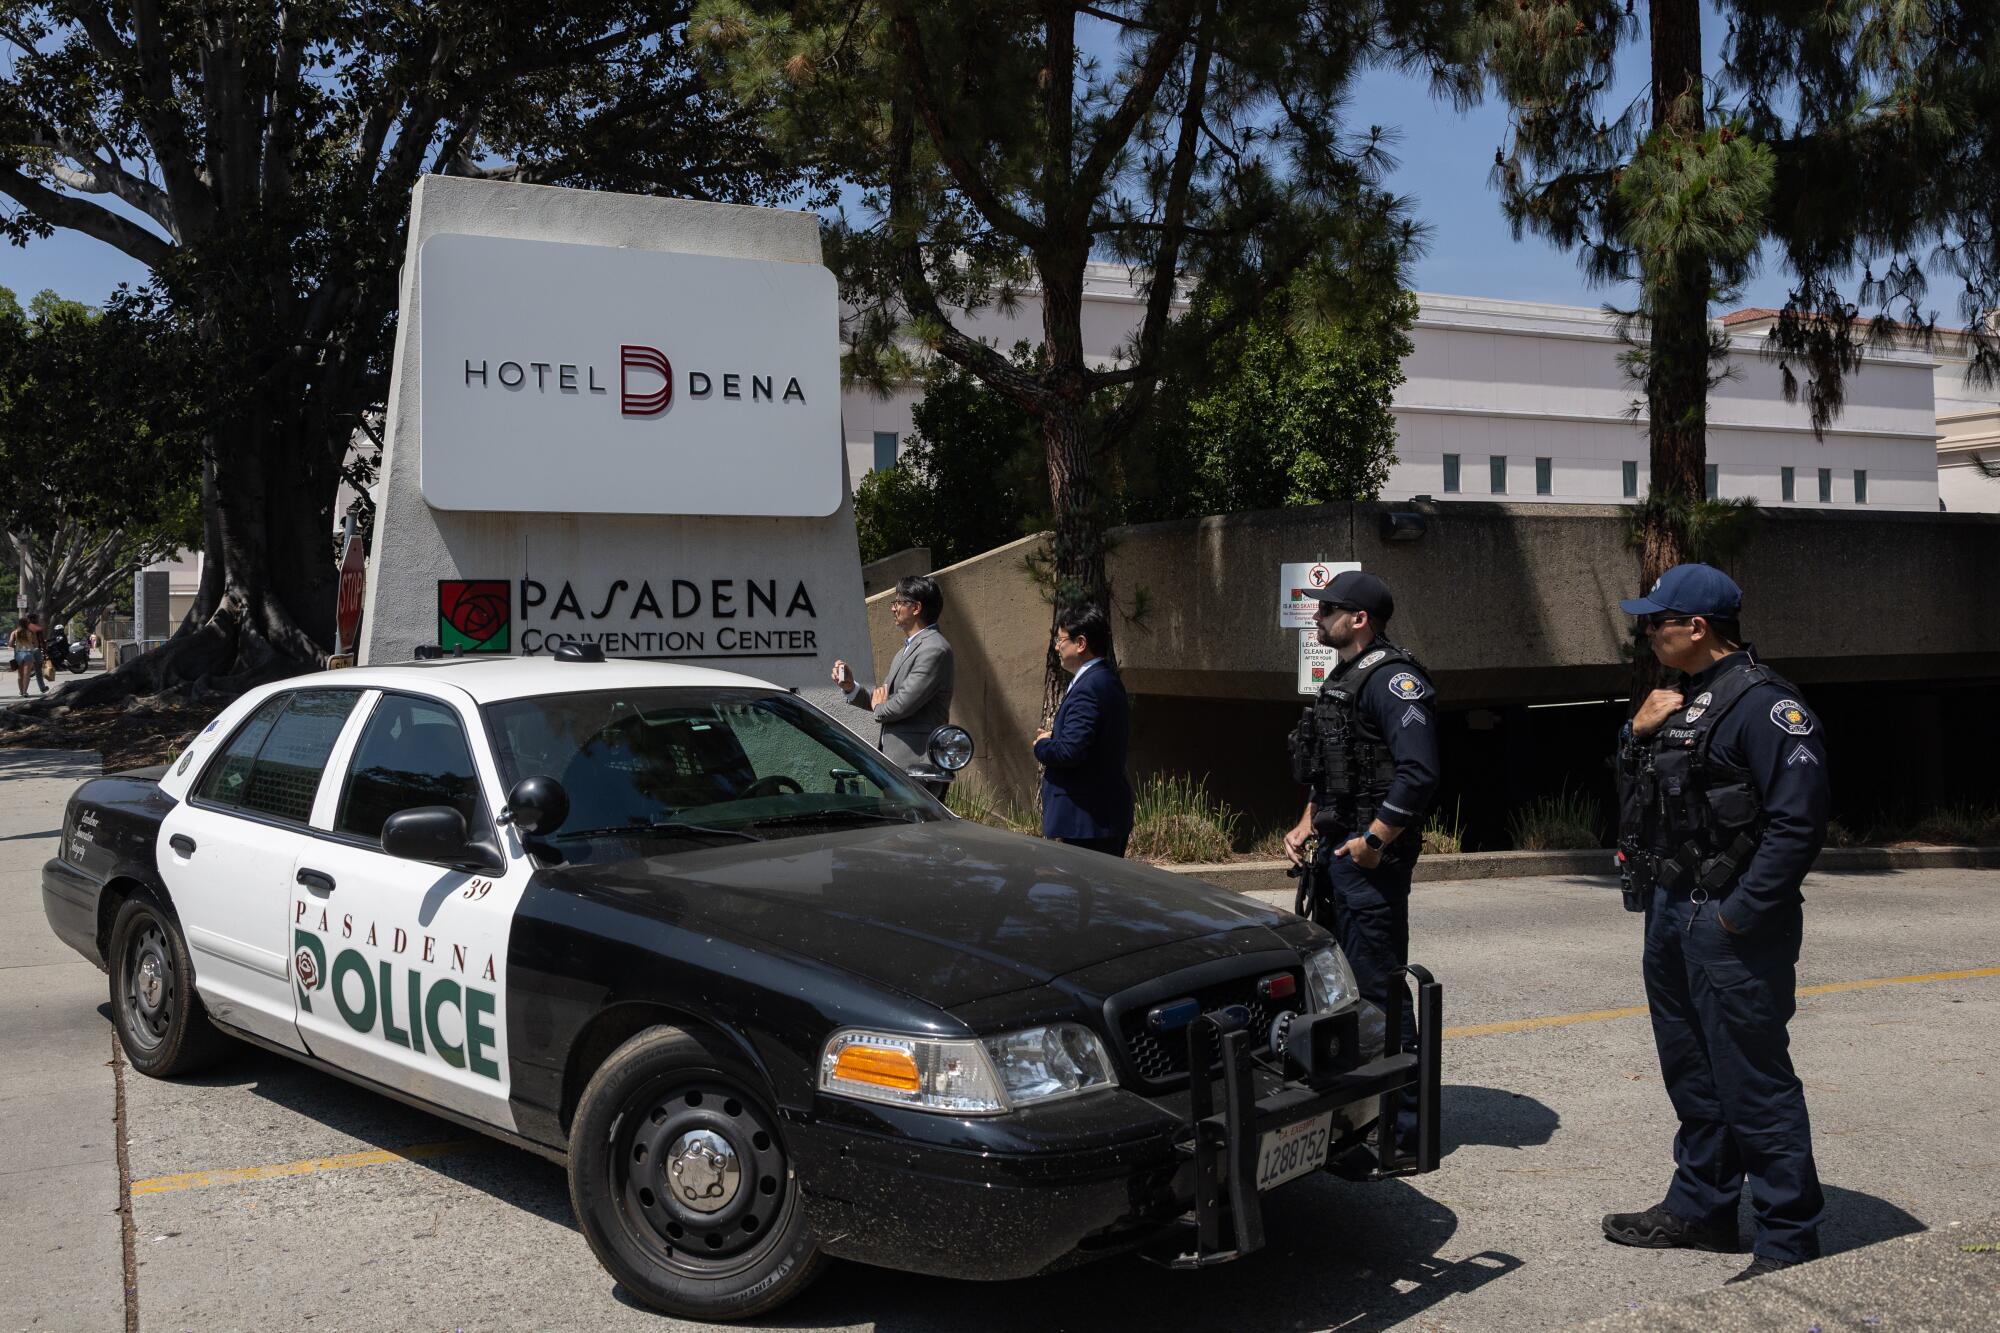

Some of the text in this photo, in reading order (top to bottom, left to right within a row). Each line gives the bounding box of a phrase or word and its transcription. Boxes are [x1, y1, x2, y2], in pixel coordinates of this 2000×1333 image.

[465, 359, 606, 391] HOTEL
[689, 371, 806, 401] DENA
[340, 571, 363, 614] STOP
[520, 579, 817, 621] PASADENA
[716, 627, 817, 650] CENTER
[1669, 729, 1696, 738] POLICE
[462, 878, 493, 901] 39
[295, 900, 497, 983] PASADENA
[294, 928, 501, 1082] POLICE
[1262, 1128, 1326, 1181] 1288752
